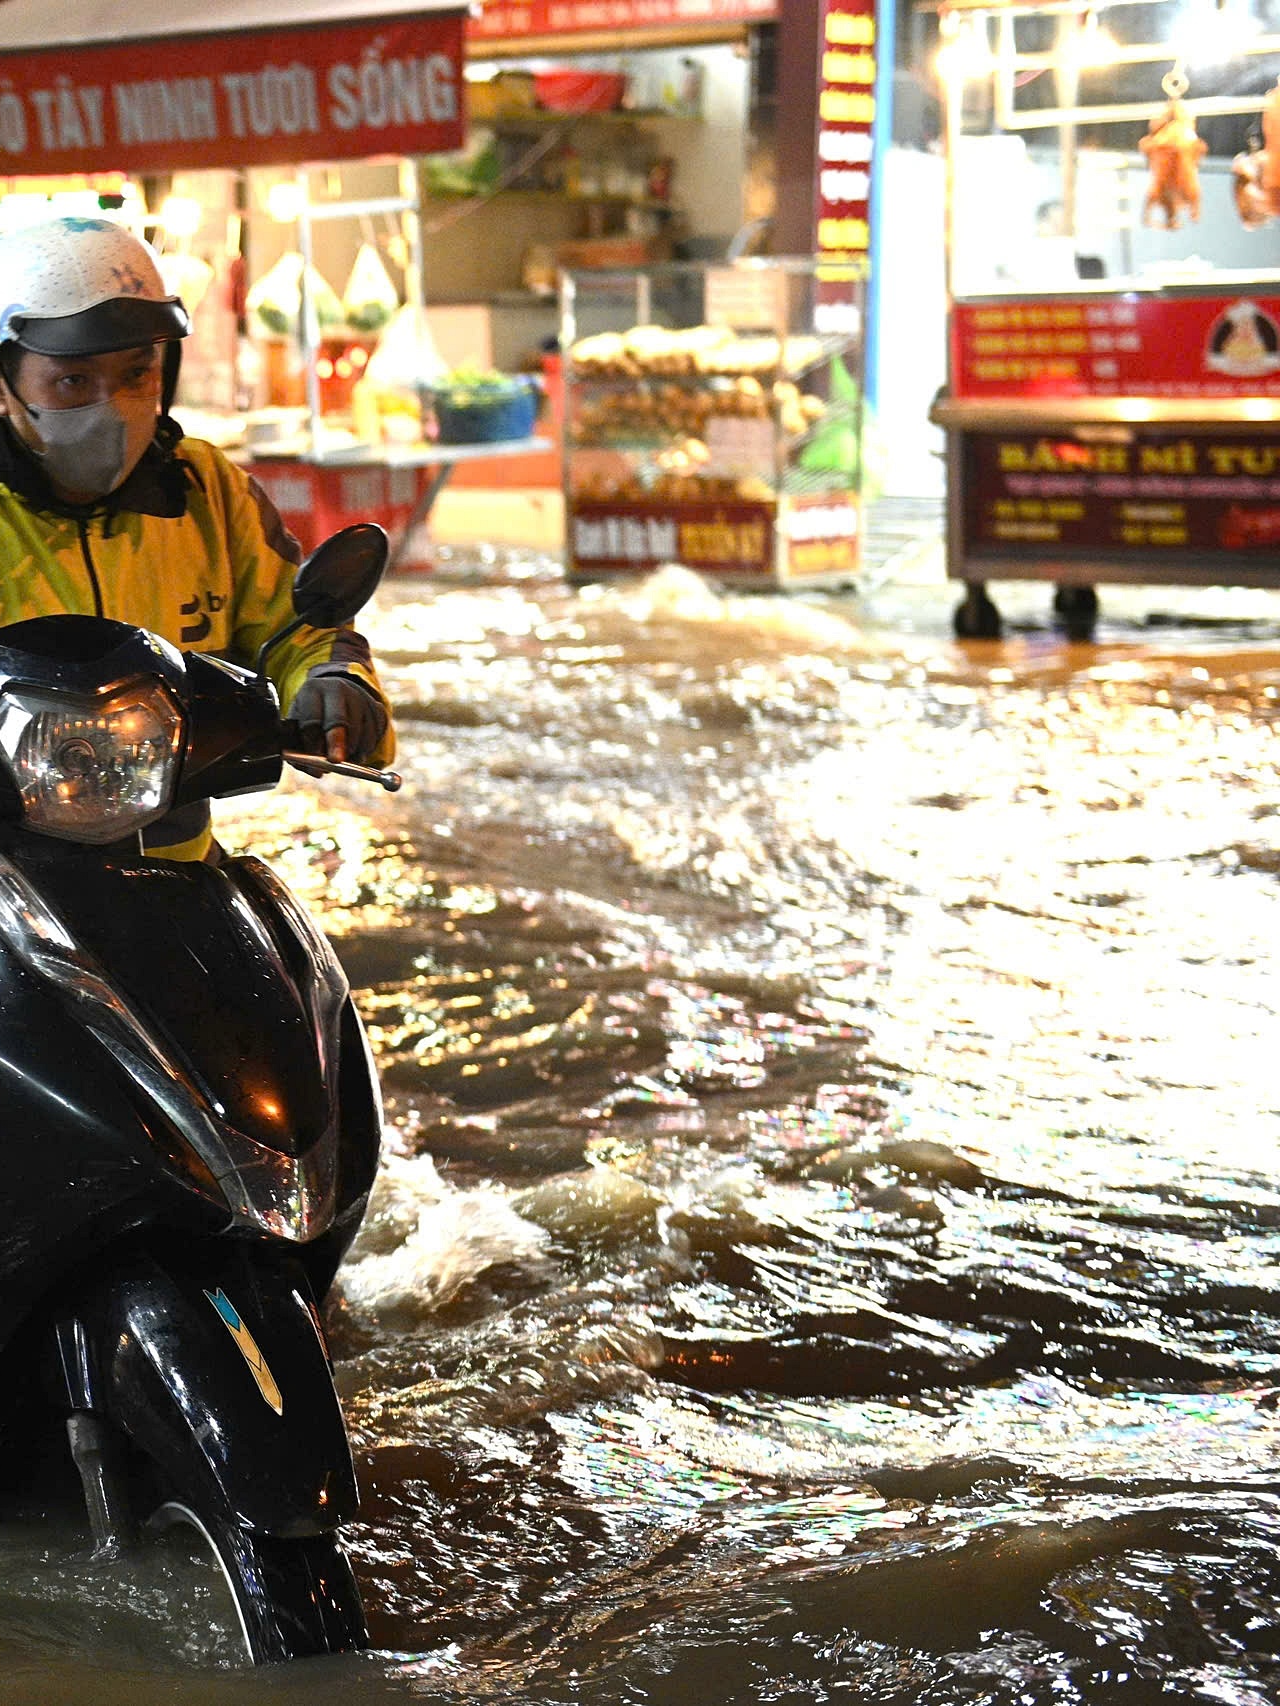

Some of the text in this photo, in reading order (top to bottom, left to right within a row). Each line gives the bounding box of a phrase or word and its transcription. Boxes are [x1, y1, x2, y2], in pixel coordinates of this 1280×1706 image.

[31, 74, 105, 151] TÂY
[113, 77, 216, 145] NINH
[223, 61, 320, 138] TƯƠI
[327, 34, 458, 131] SỐNG
